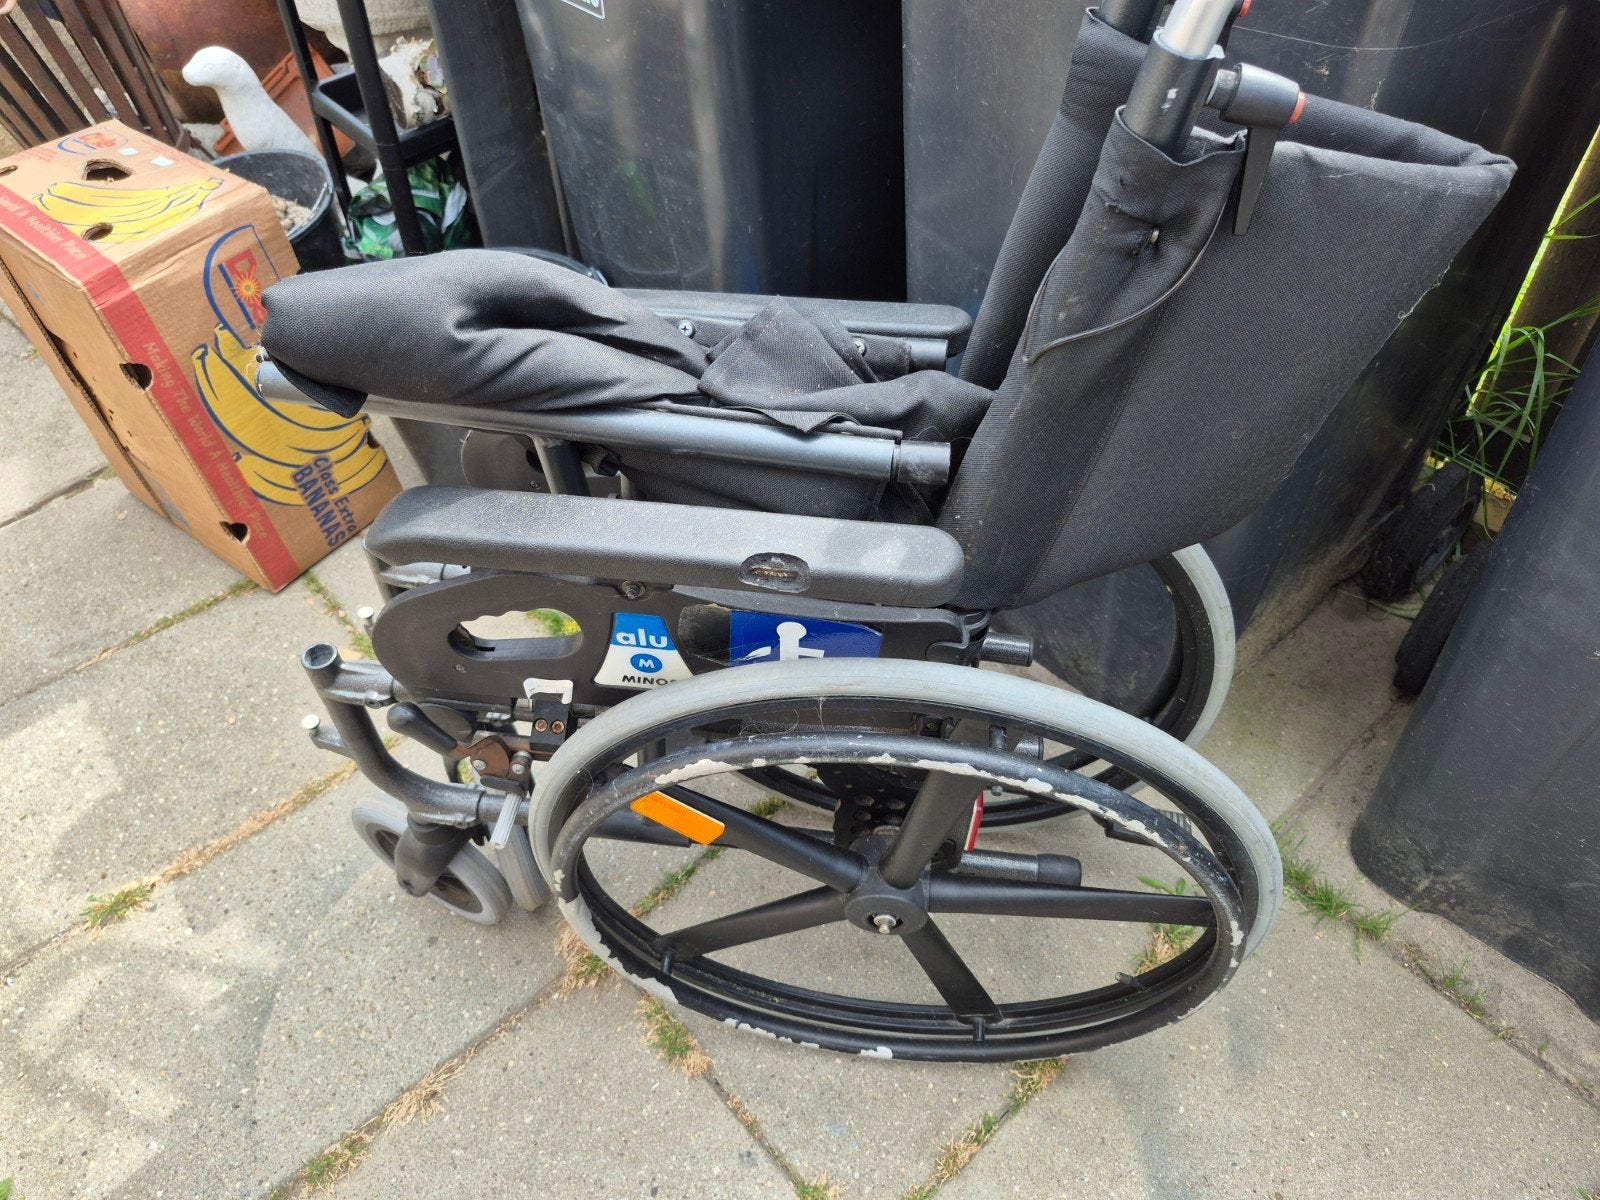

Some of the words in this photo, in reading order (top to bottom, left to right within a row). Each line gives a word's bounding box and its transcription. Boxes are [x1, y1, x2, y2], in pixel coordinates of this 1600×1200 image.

[143, 342, 175, 389] Making
[174, 387, 191, 414] The
[187, 415, 215, 448] World
[209, 450, 221, 460] A
[216, 461, 251, 514] Healthier
[247, 505, 269, 539] Place
[292, 465, 347, 547] BANANAS
[314, 457, 339, 495] Class
[335, 496, 357, 533] Extra
[615, 628, 668, 648] alu
[638, 658, 655, 669] M
